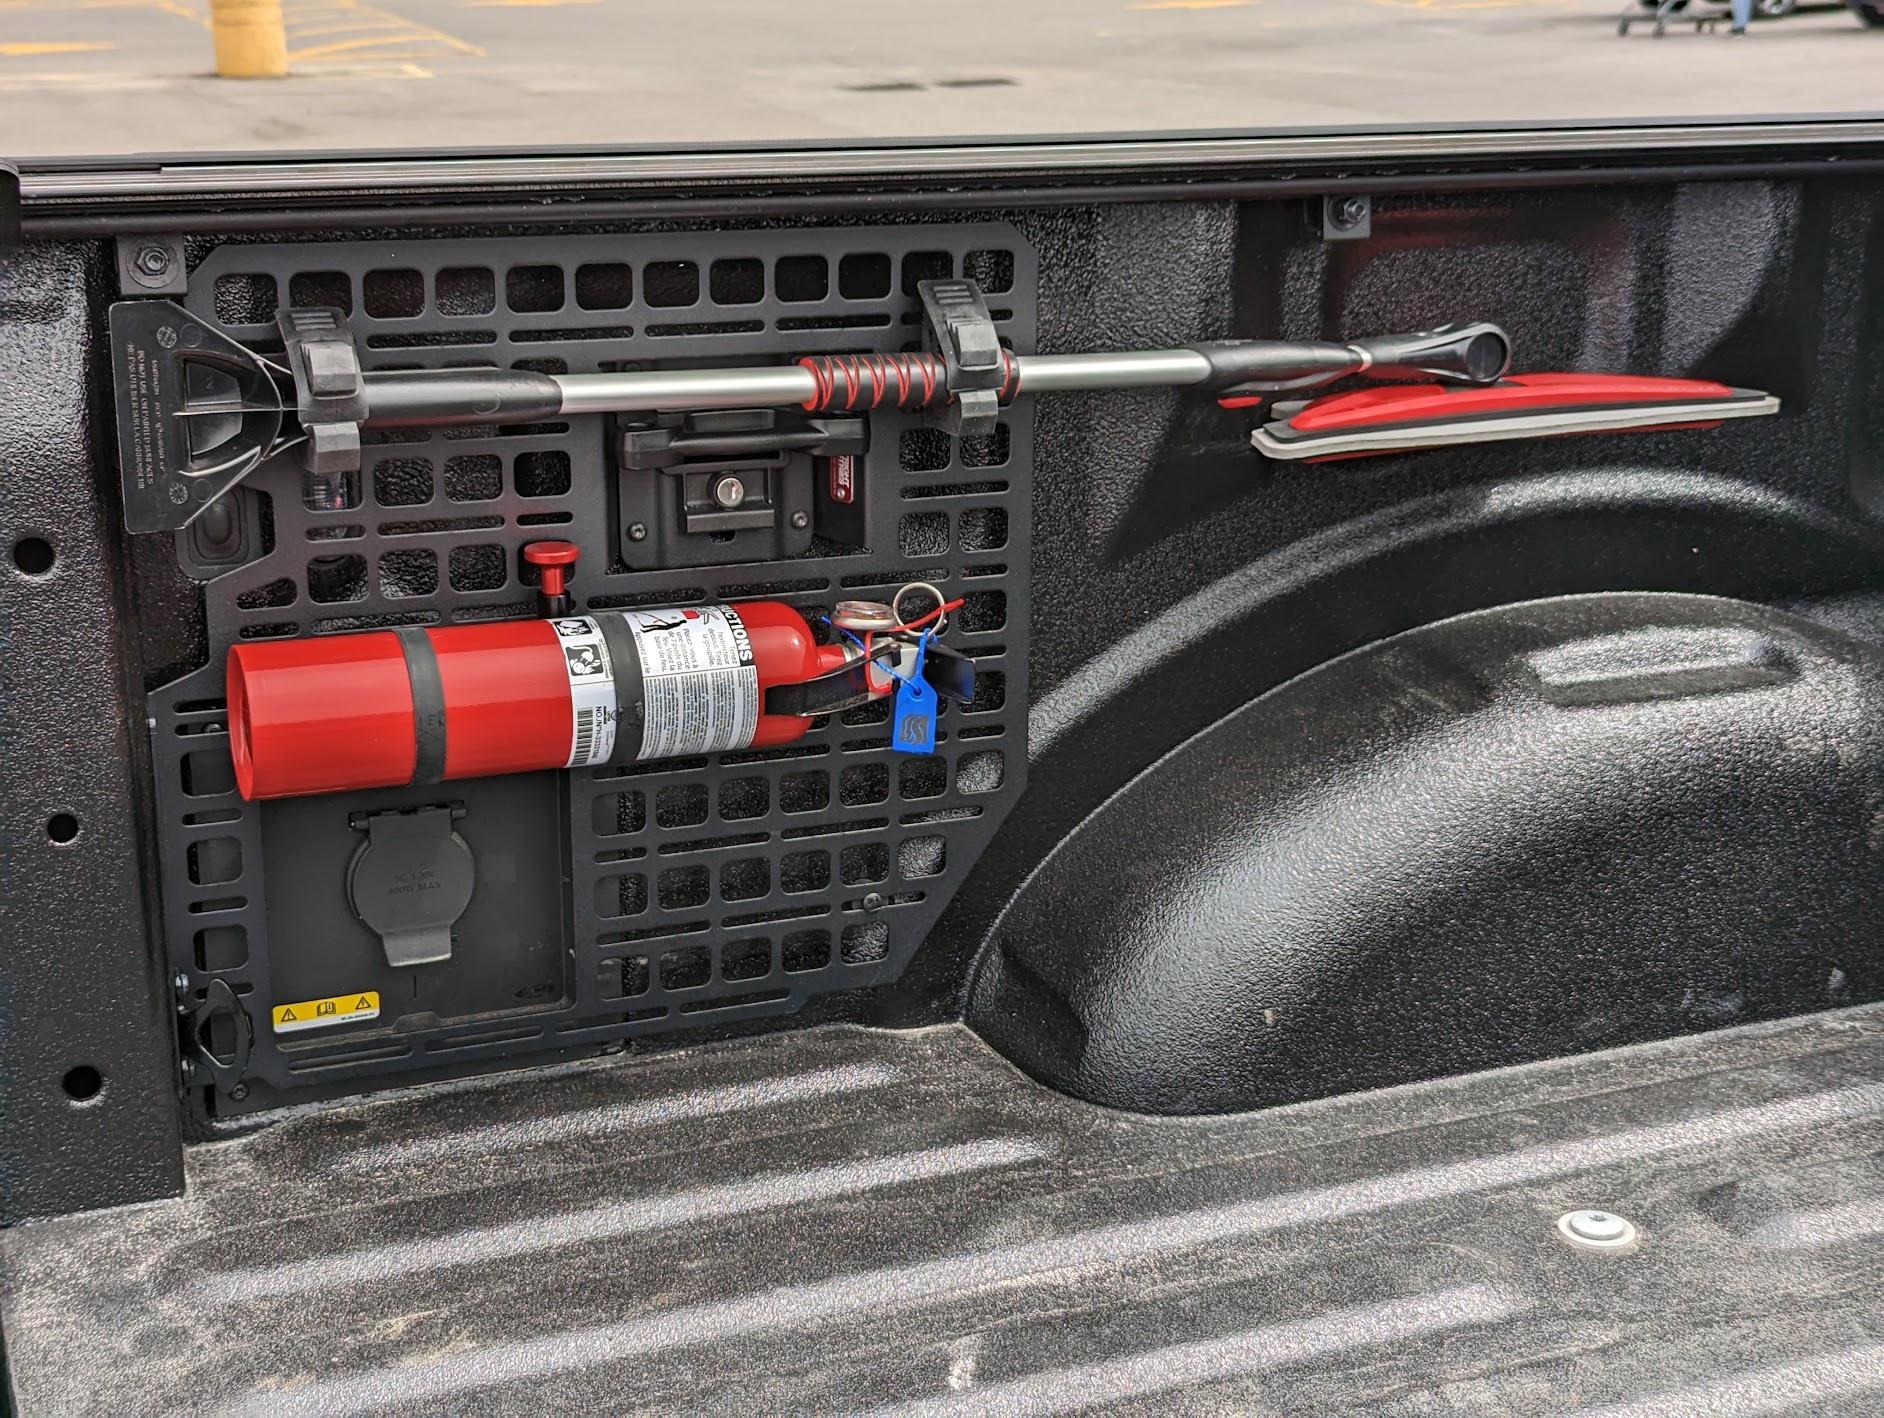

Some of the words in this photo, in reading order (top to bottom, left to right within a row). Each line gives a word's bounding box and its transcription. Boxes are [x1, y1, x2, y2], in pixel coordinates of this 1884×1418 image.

[635, 632, 647, 655] Appuyez
[654, 636, 662, 649] base
[659, 650, 666, 659] de
[666, 648, 674, 664] Visez
[677, 661, 683, 670] du
[680, 643, 690, 669] distance
